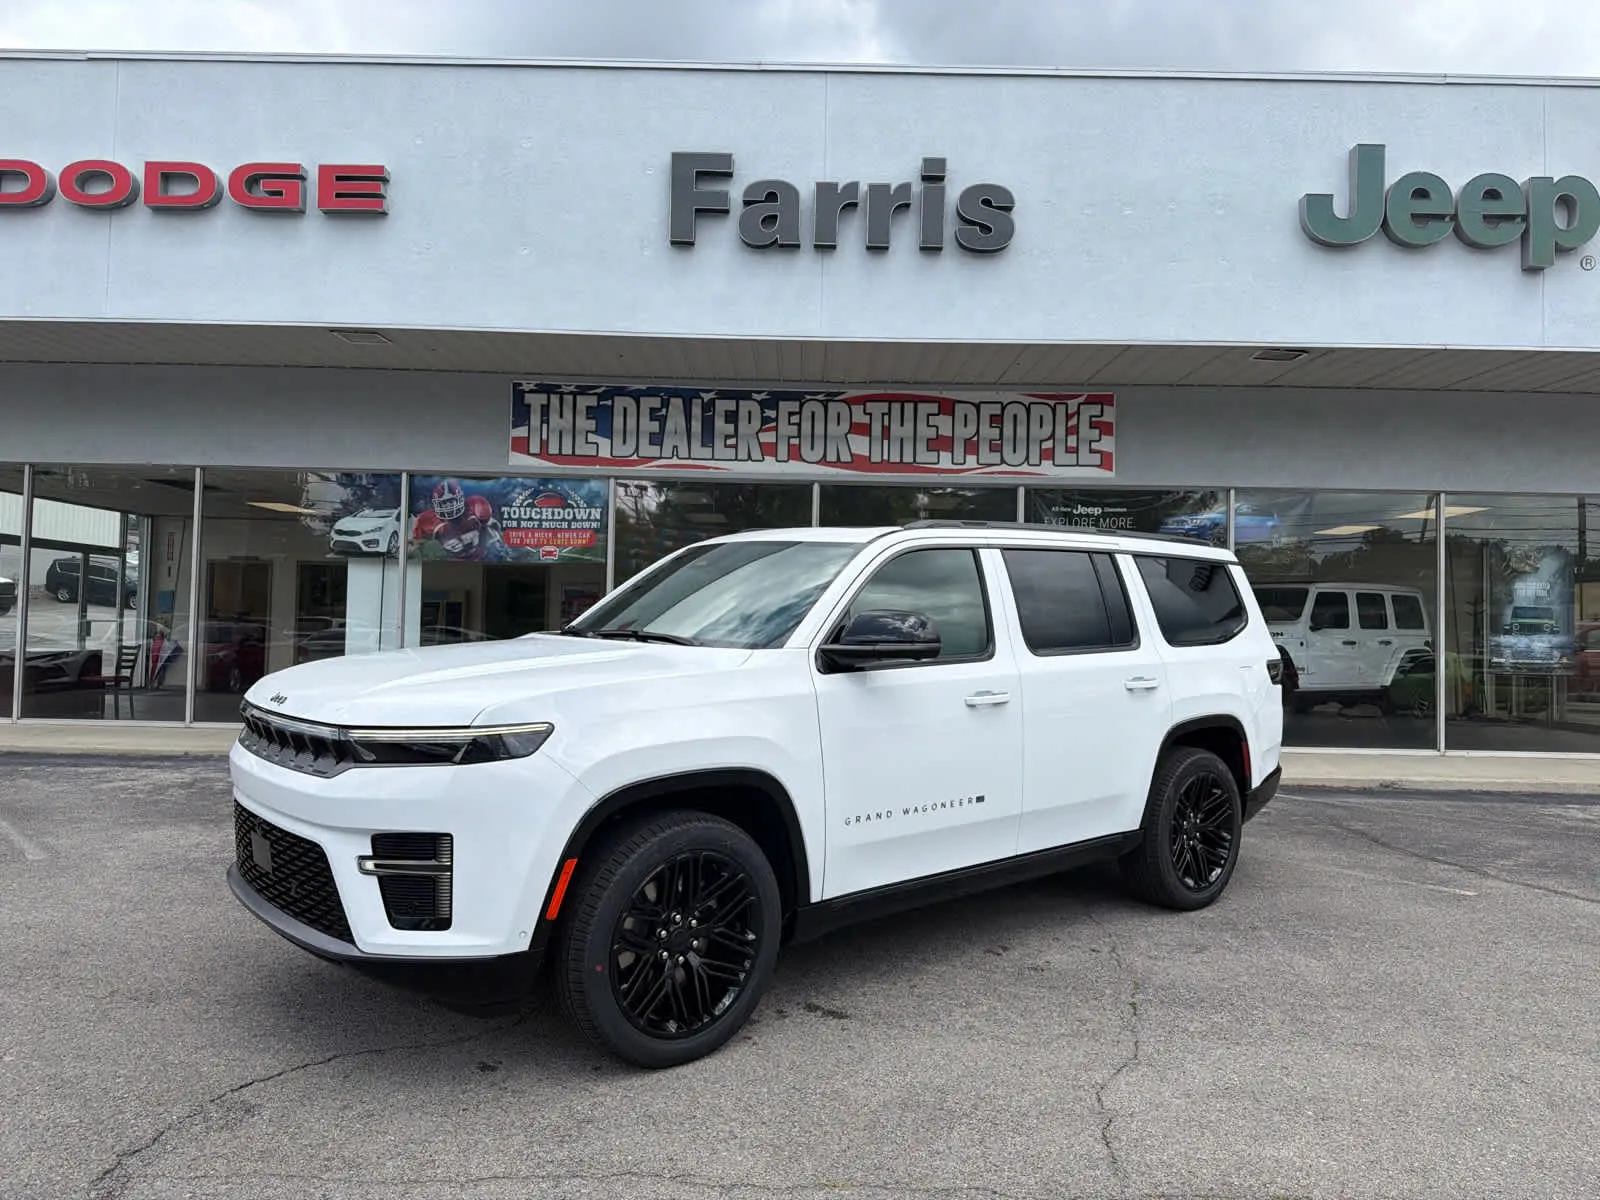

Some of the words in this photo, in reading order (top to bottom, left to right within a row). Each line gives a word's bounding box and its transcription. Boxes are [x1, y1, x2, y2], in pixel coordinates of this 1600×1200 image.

[0, 159, 390, 215] DODGE
[669, 152, 1015, 253] Farris
[1300, 143, 1600, 271] Jeep
[524, 391, 599, 456] THE
[611, 395, 764, 462] DEALER
[775, 399, 853, 464] FOR
[864, 401, 940, 465] THE
[951, 401, 1103, 467] PEOPLE
[501, 507, 602, 520] TOUCHDOWN
[1073, 504, 1102, 516] Jeep
[502, 520, 518, 528] FOR
[542, 521, 568, 529] MUCH
[570, 521, 601, 529] DOWN!
[1044, 516, 1096, 528] EXPLORE
[270, 692, 288, 707] Jeep
[844, 809, 893, 826] GRAND
[902, 796, 974, 816] WAGONEER
